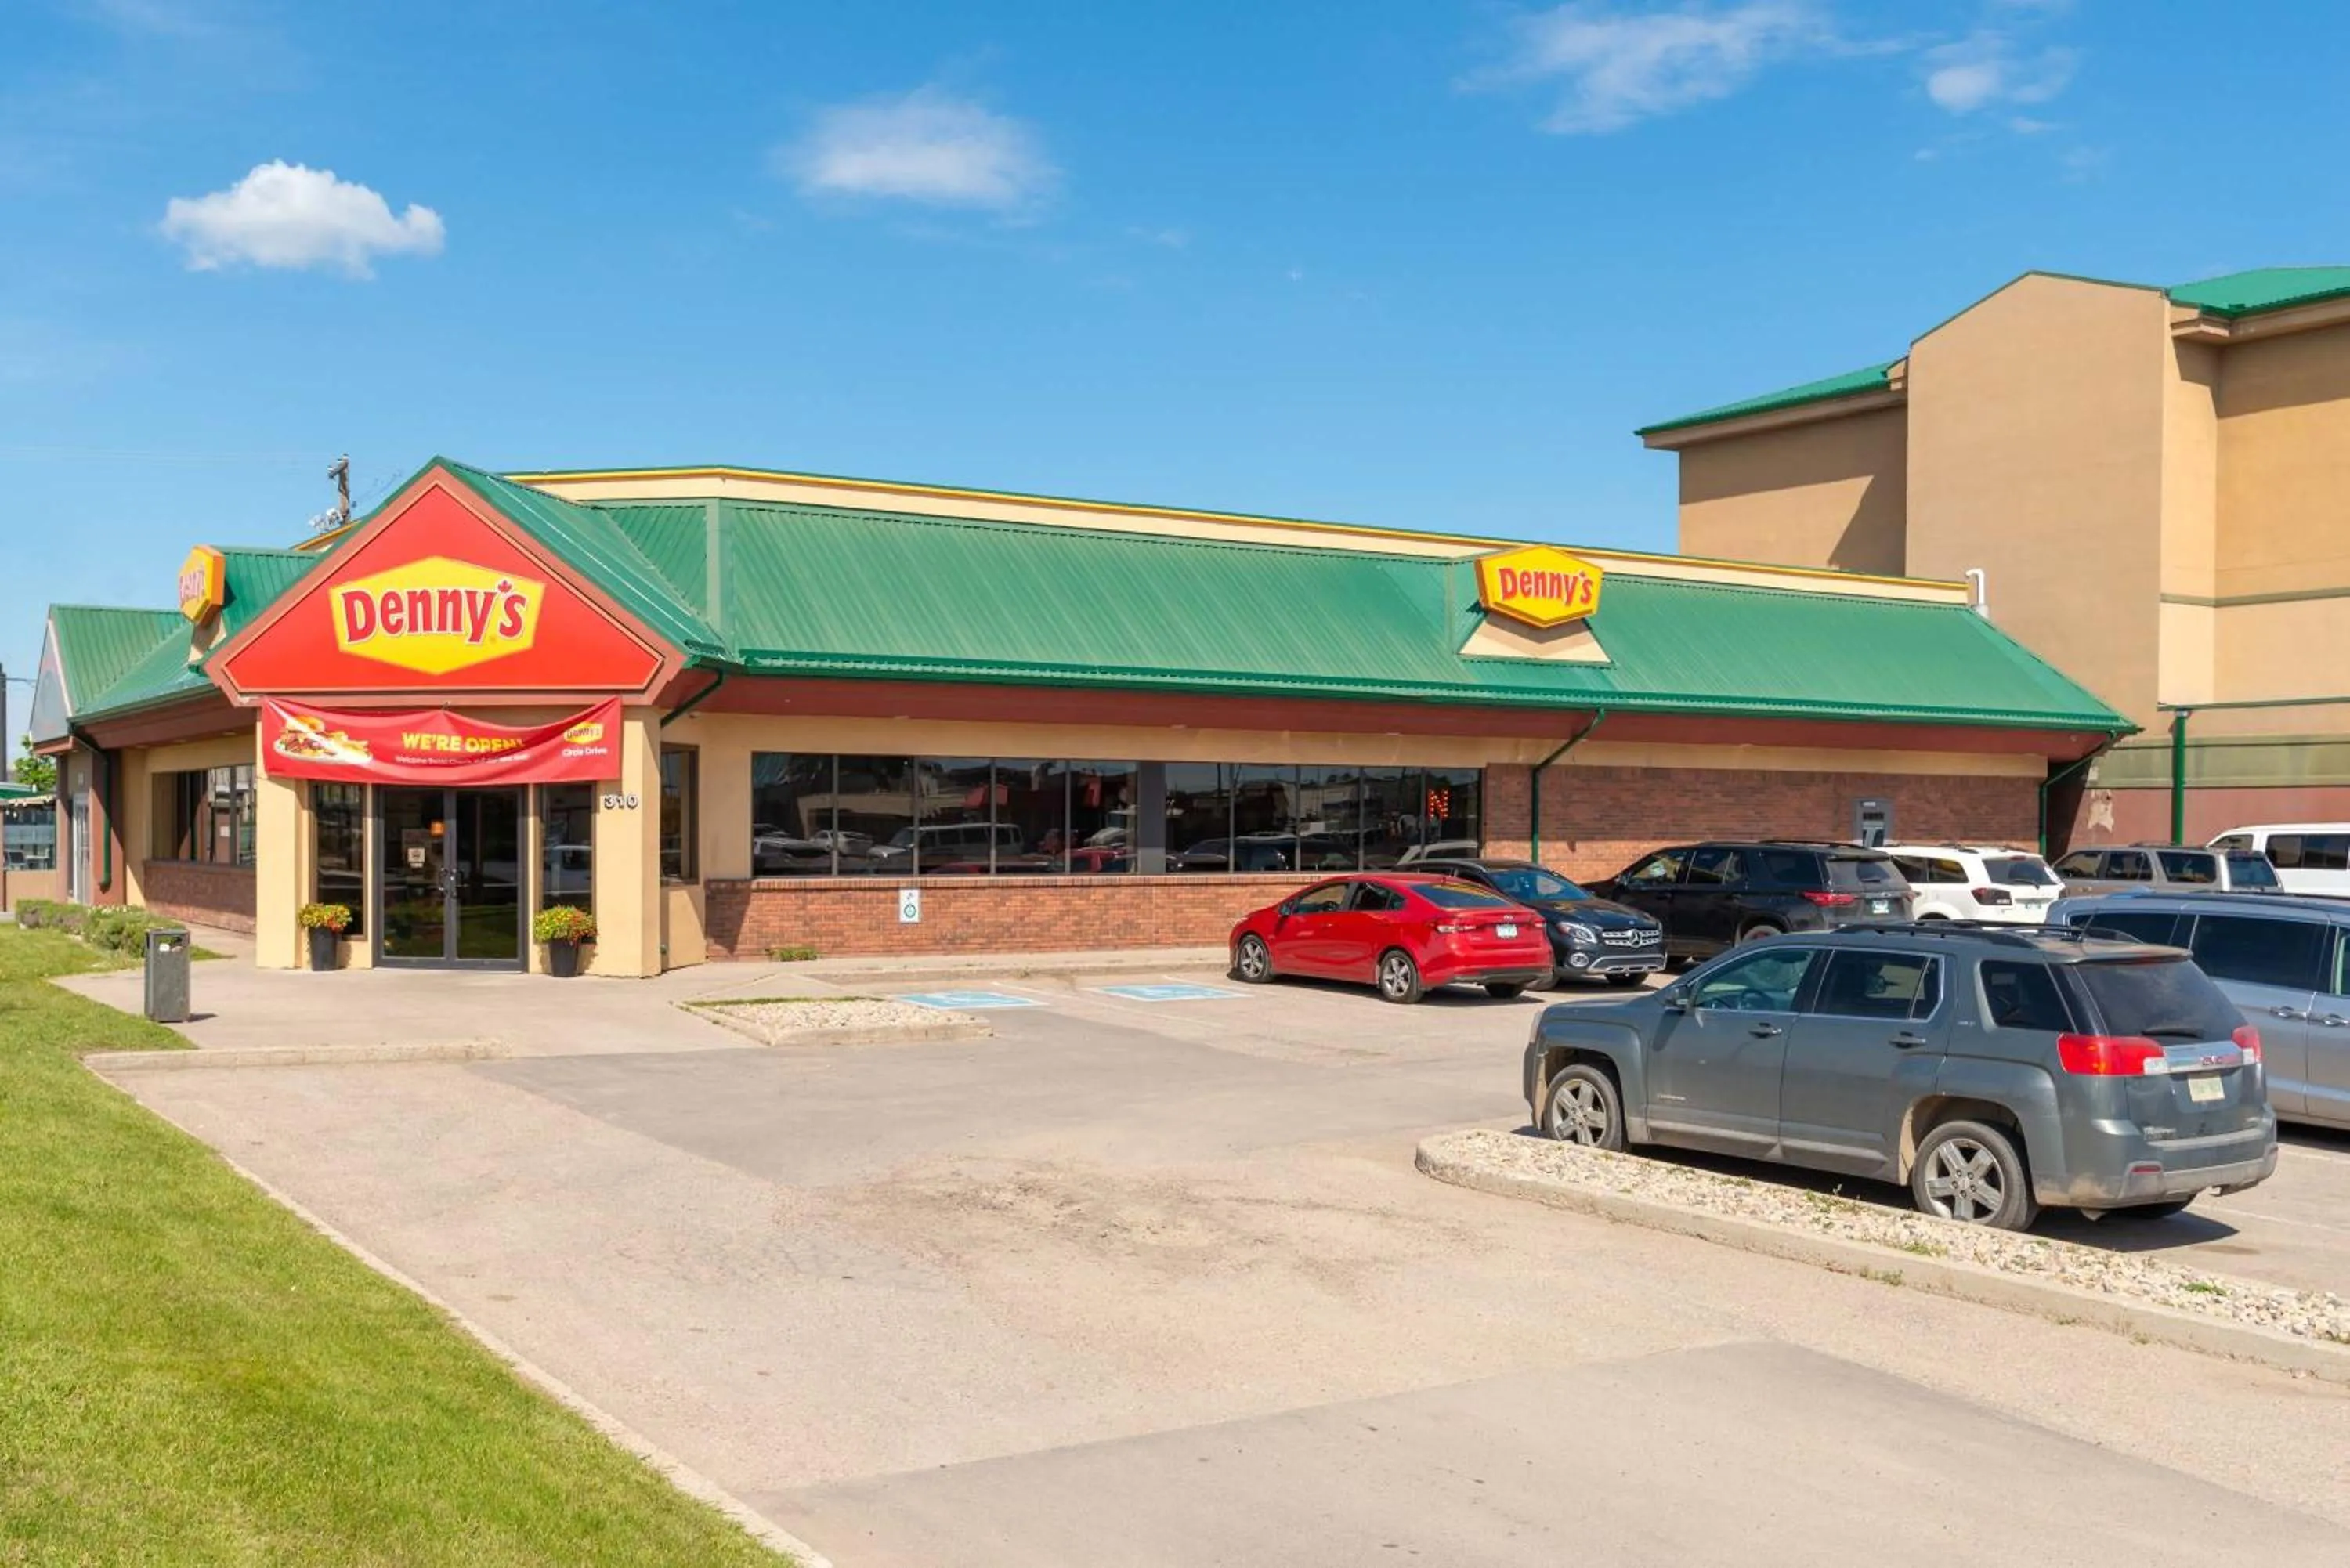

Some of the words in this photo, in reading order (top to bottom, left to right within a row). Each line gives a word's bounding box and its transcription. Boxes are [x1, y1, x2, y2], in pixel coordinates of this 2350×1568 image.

[1499, 568, 1594, 607] Denny's
[340, 579, 528, 645] Denny's
[402, 732, 461, 752] WE'RE
[584, 747, 608, 756] Drive
[603, 793, 638, 810] 310
